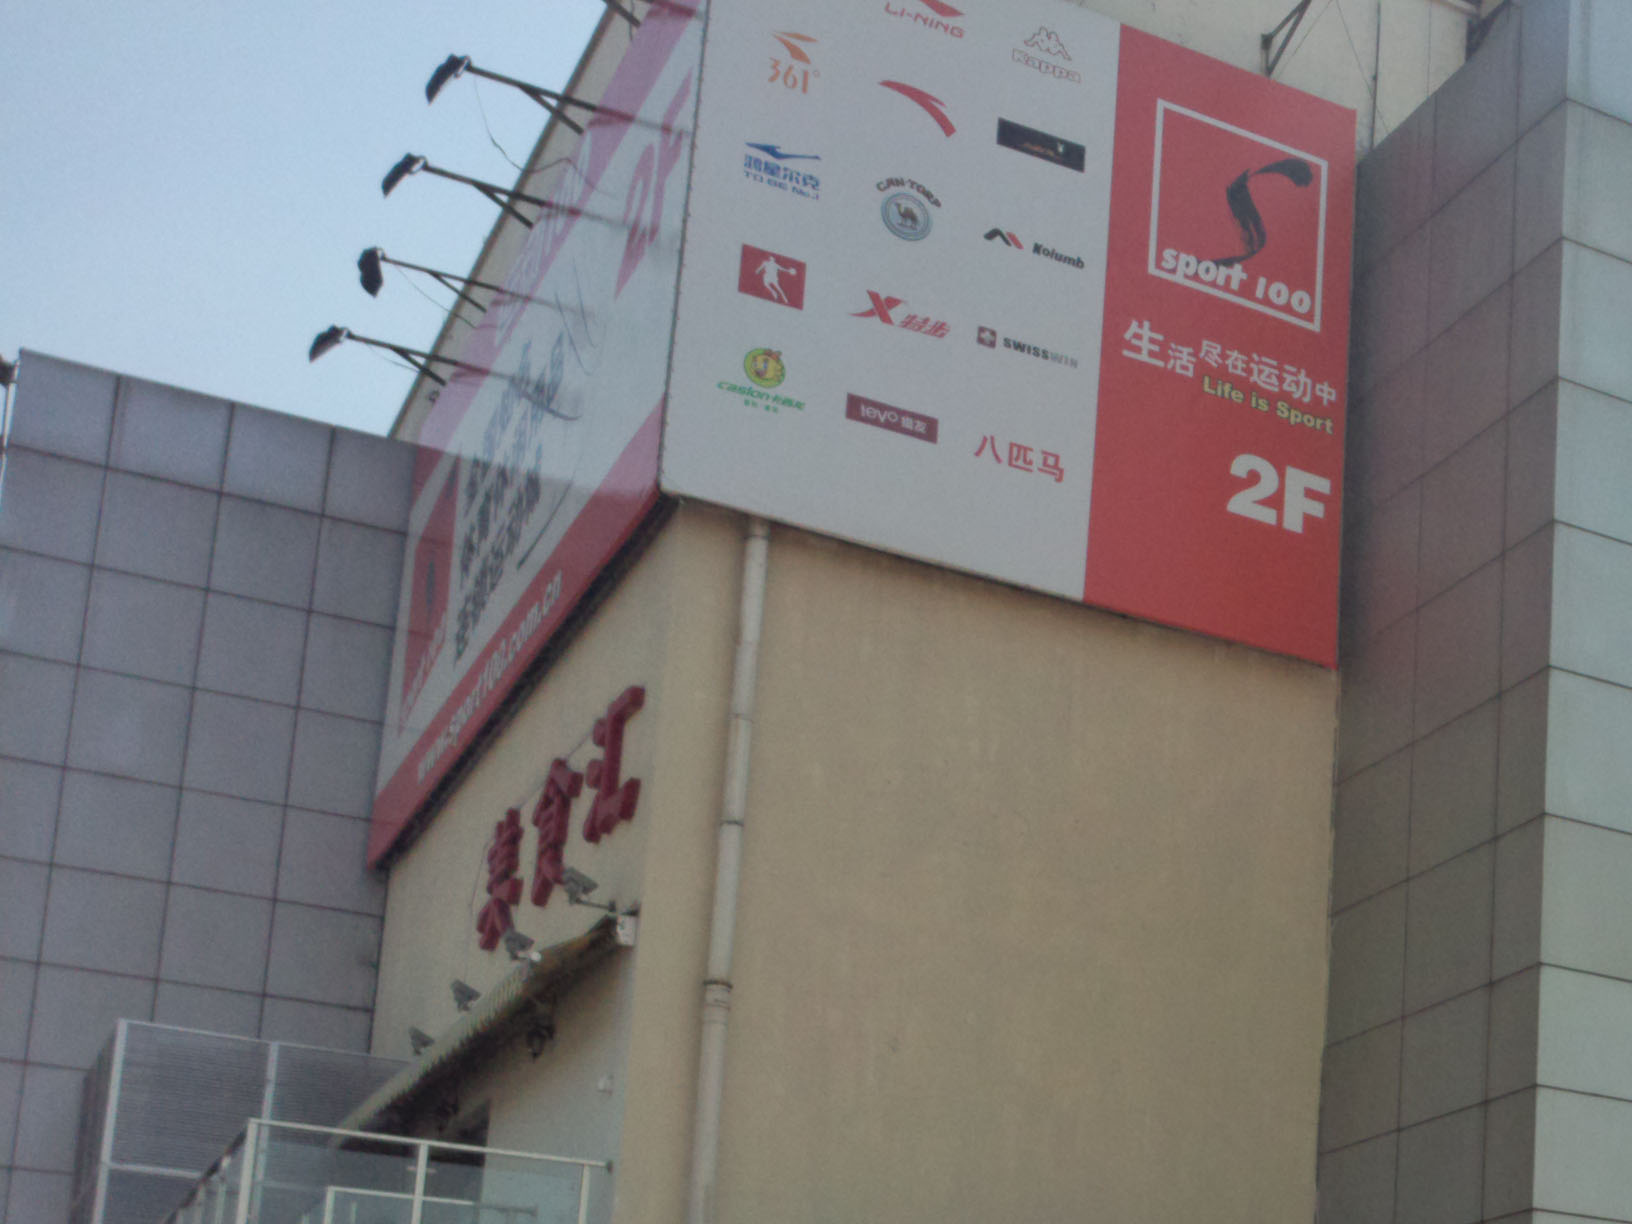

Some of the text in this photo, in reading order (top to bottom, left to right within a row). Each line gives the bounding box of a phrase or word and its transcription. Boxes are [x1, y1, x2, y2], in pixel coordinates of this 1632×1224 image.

[884, 2, 964, 39] LI-NING
[768, 56, 820, 94] 361°
[1162, 248, 1312, 315] sport 100
[1122, 319, 1337, 406] 生活尽在运动中
[1203, 374, 1334, 435] Life is Sport
[974, 435, 1064, 484] 八匹马
[1226, 453, 1332, 534] 2F
